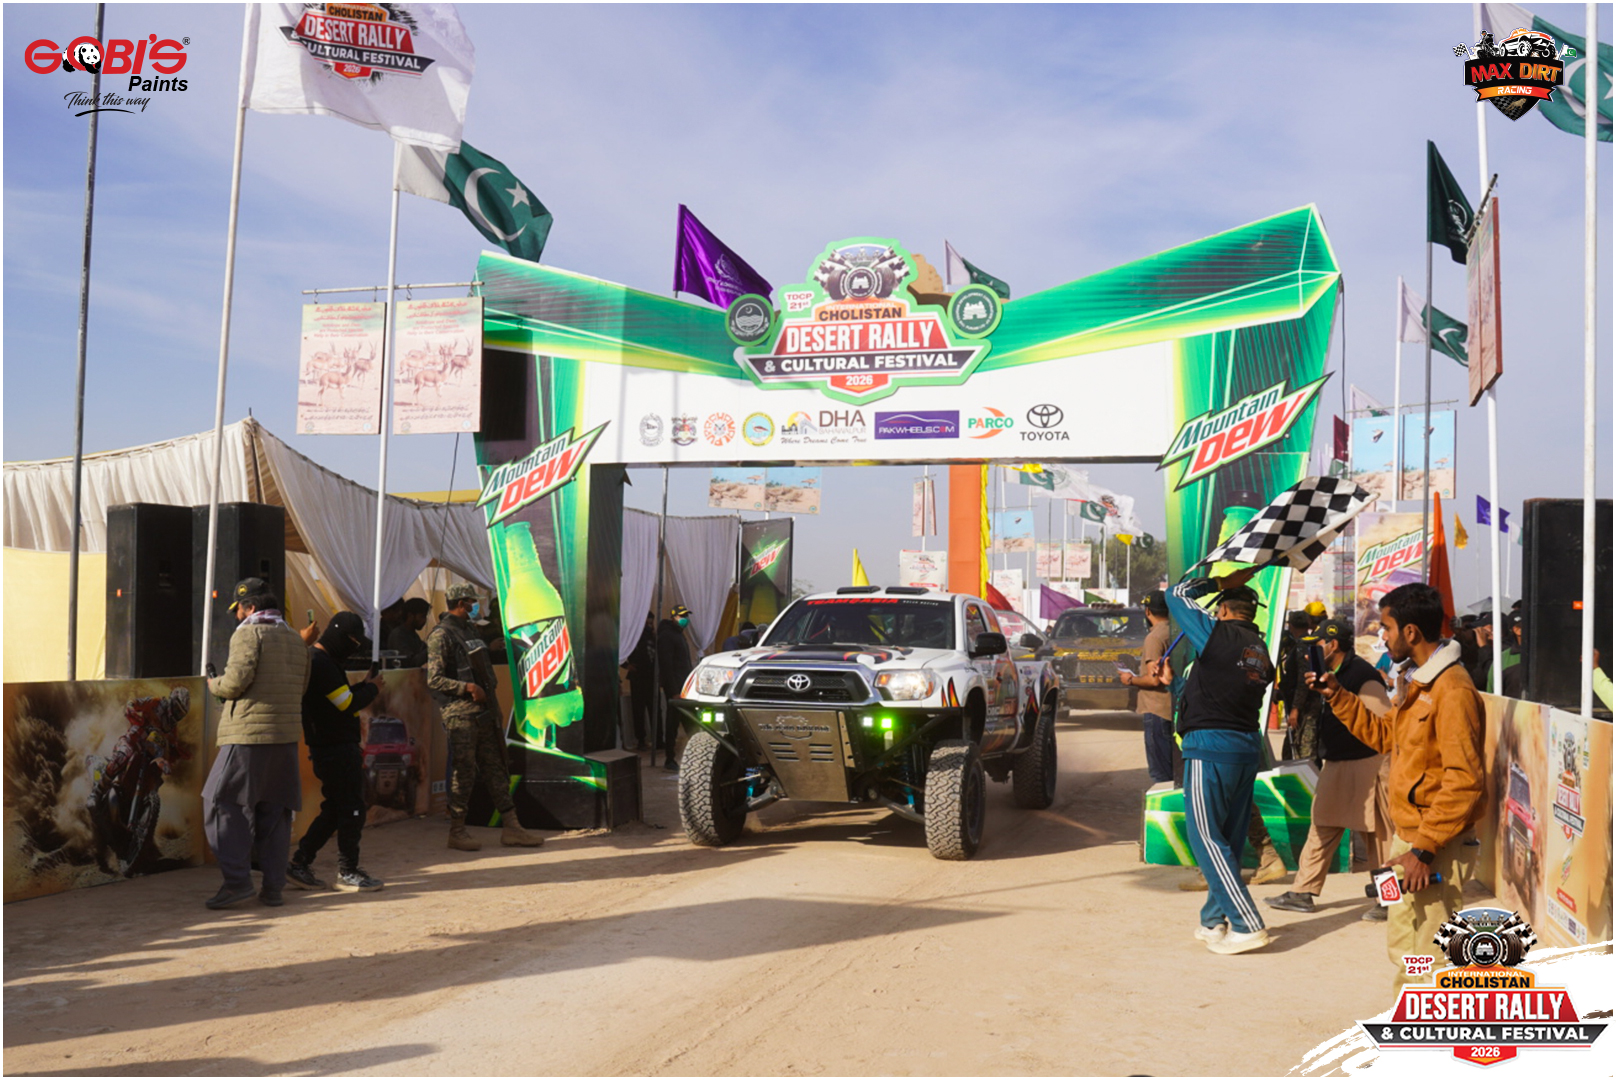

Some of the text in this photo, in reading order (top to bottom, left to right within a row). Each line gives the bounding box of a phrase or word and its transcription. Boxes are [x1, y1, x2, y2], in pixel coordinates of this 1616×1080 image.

[328, 6, 383, 22] CHOLISTAN
[305, 14, 407, 50] DESERT RALLY
[362, 51, 421, 69] FESTIVAL
[344, 64, 361, 74] 2026
[786, 292, 812, 301] TDCP
[790, 301, 810, 310] 21st
[824, 302, 898, 311] INTERNATIONAL
[818, 308, 902, 321] CHOLISTAN
[786, 321, 934, 353] DESERT RALLY
[764, 352, 958, 373] & CULTURAL FESTIVAL
[846, 375, 873, 386] 2026
[819, 410, 866, 427] DHA
[968, 417, 1014, 429] PARCO
[1172, 388, 1280, 455] Mountain
[830, 436, 849, 444] Come
[1020, 431, 1070, 441] TOYOTA
[485, 436, 567, 496] Mountain
[1360, 532, 1421, 566] Mountain
